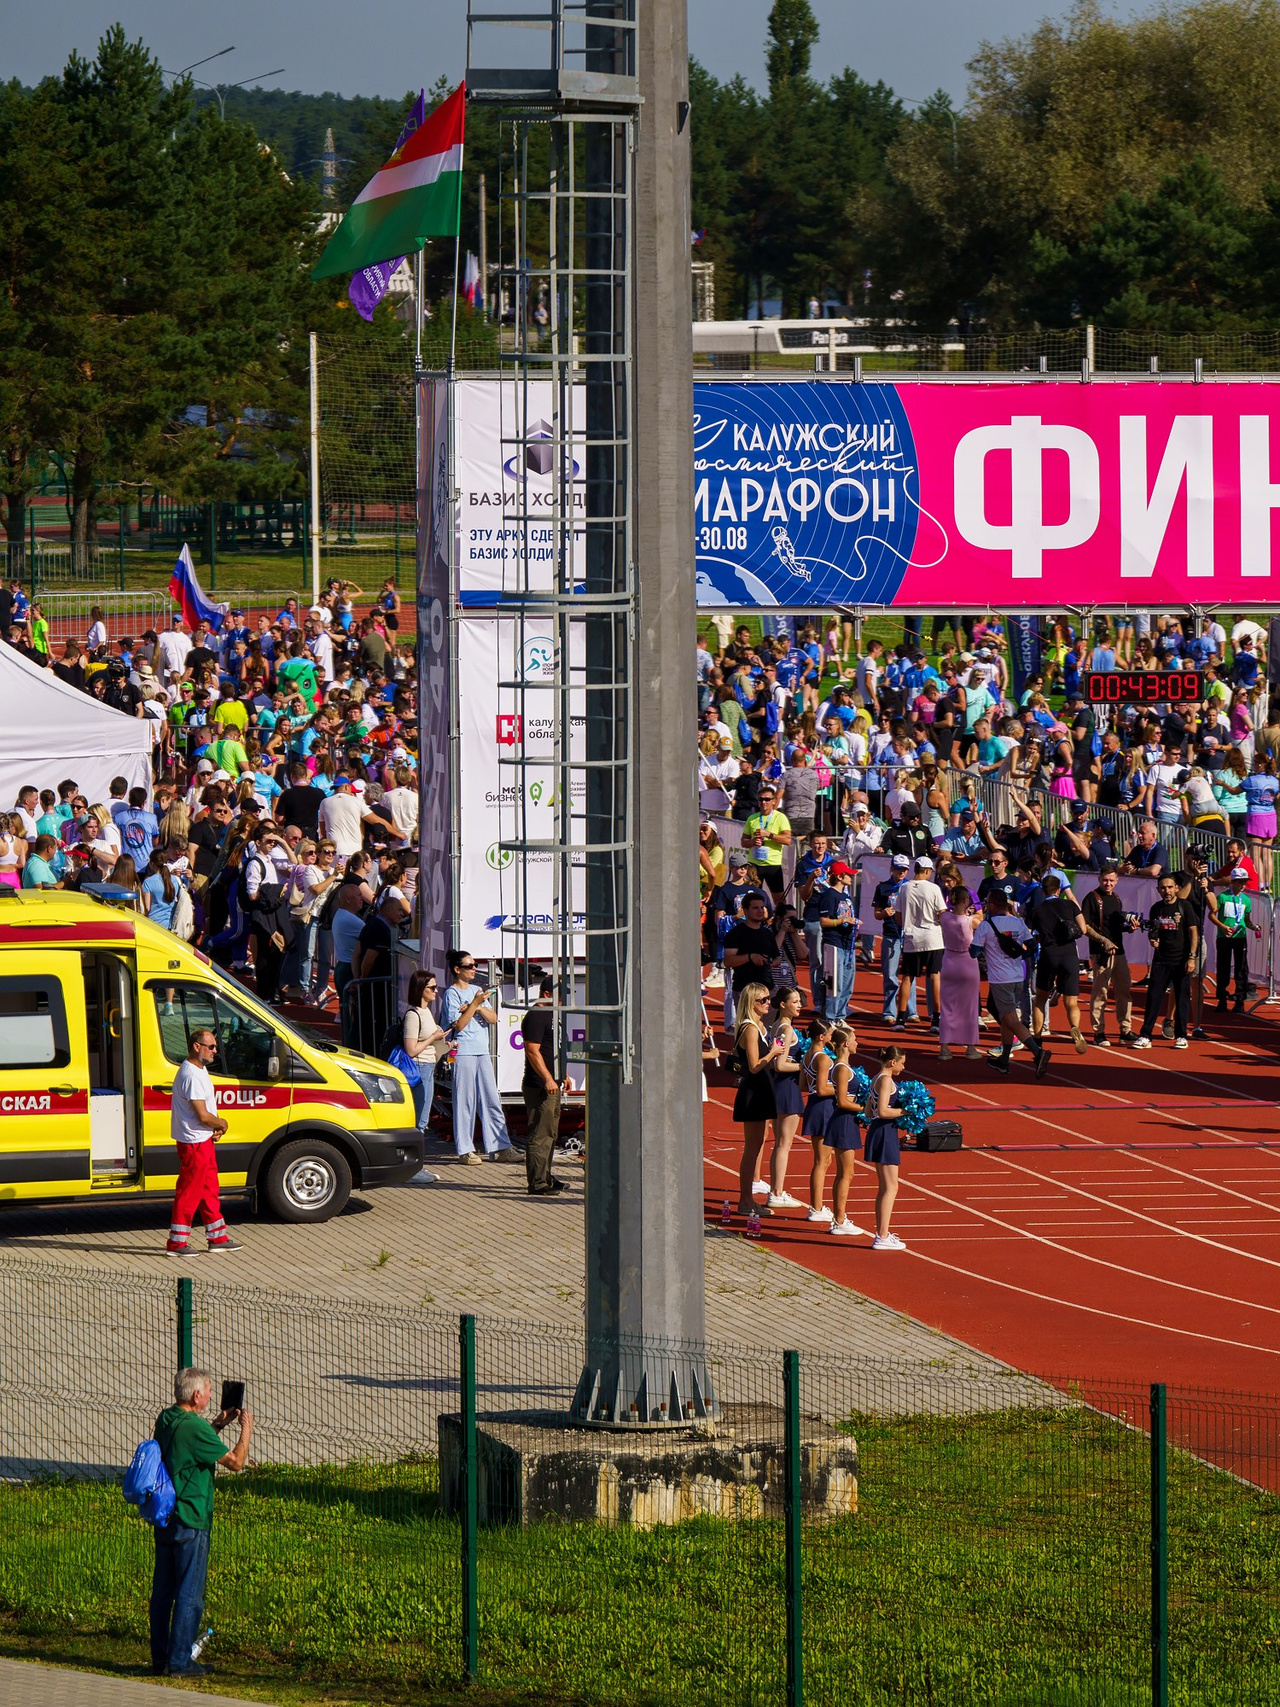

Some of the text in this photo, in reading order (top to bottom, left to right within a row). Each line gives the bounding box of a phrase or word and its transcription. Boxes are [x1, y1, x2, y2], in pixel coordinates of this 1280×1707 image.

[362, 269, 381, 298] ОБЛАСТИ
[812, 331, 848, 344] Panra
[733, 419, 894, 452] КАЛУЖСКИЙ
[694, 430, 914, 473] осмический
[532, 492, 586, 508] ХОЛД
[470, 529, 580, 542] ЭТУ АРКУ СДЕАЛ
[695, 526, 747, 550] -30.08
[470, 548, 508, 560] БАЗИС
[1090, 675, 1198, 700] 00:43:09
[529, 719, 586, 729] калукая
[529, 730, 574, 739] облаь
[430, 598, 447, 990] ПОРТ 40
[518, 857, 552, 865] аужской
[0, 1095, 51, 1111] СКАЯ
